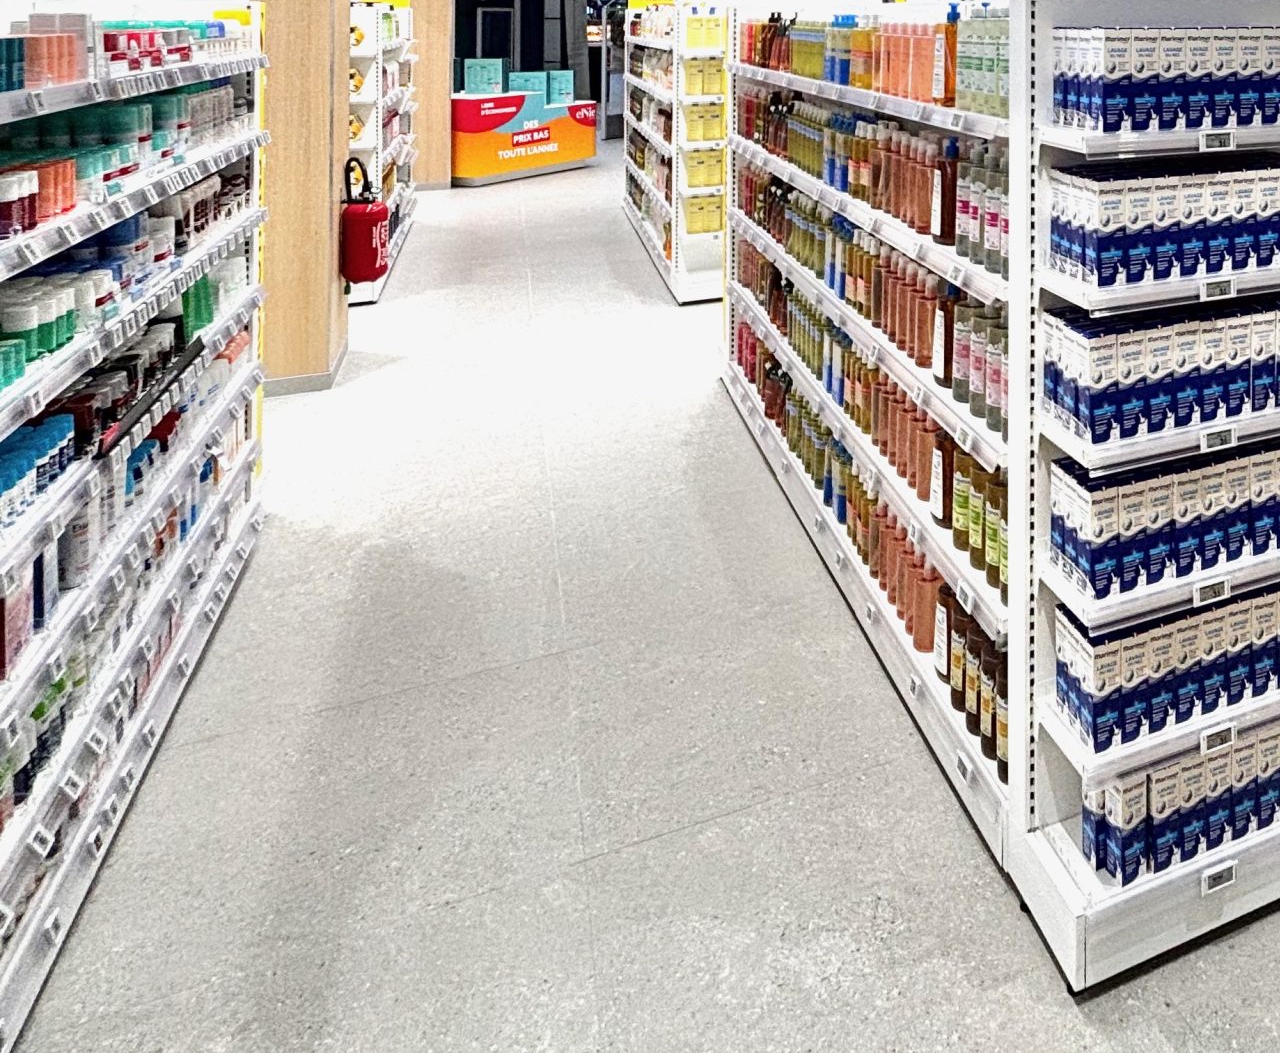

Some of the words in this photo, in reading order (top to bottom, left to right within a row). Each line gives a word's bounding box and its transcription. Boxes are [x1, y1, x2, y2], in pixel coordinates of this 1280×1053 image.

[524, 119, 540, 130] DES
[513, 133, 532, 145] PRIX
[533, 129, 550, 141] BAS
[497, 148, 526, 160] TOUTE
